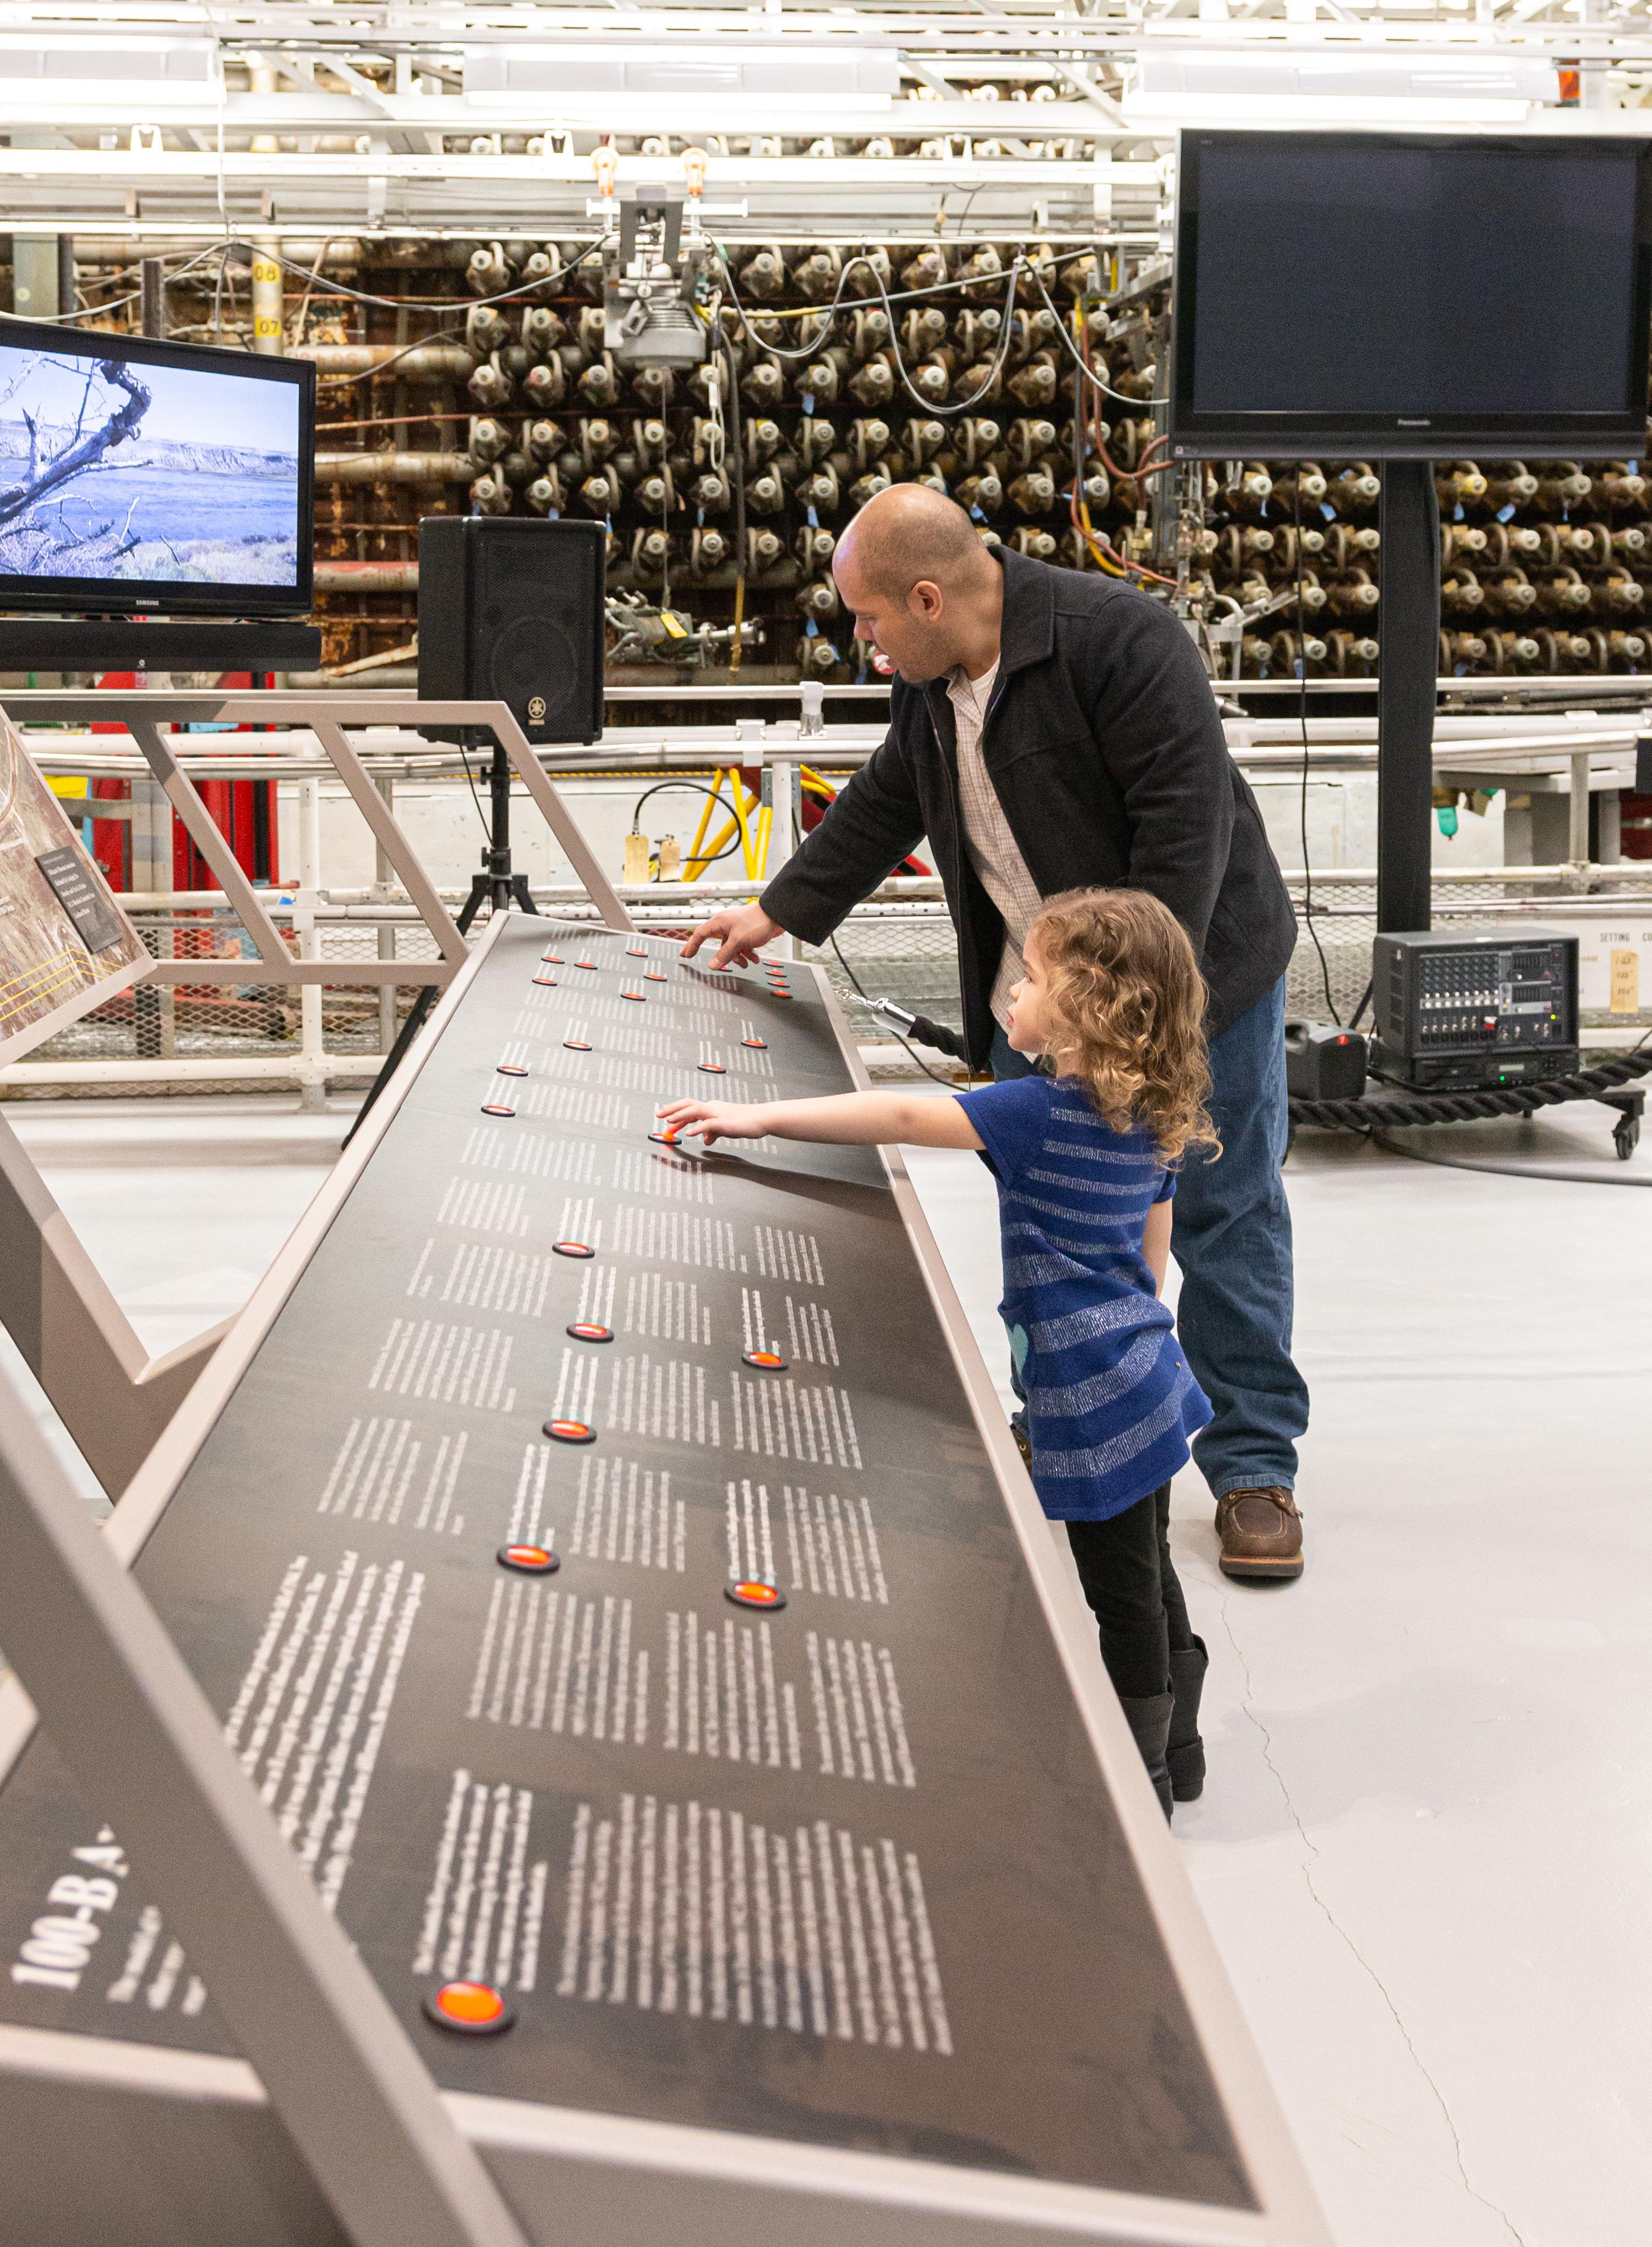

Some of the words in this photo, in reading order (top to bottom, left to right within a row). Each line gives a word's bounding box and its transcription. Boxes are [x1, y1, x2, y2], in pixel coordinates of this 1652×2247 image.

[255, 265, 276, 280] 08
[260, 319, 278, 334] 07
[1600, 932, 1630, 942] SETTING
